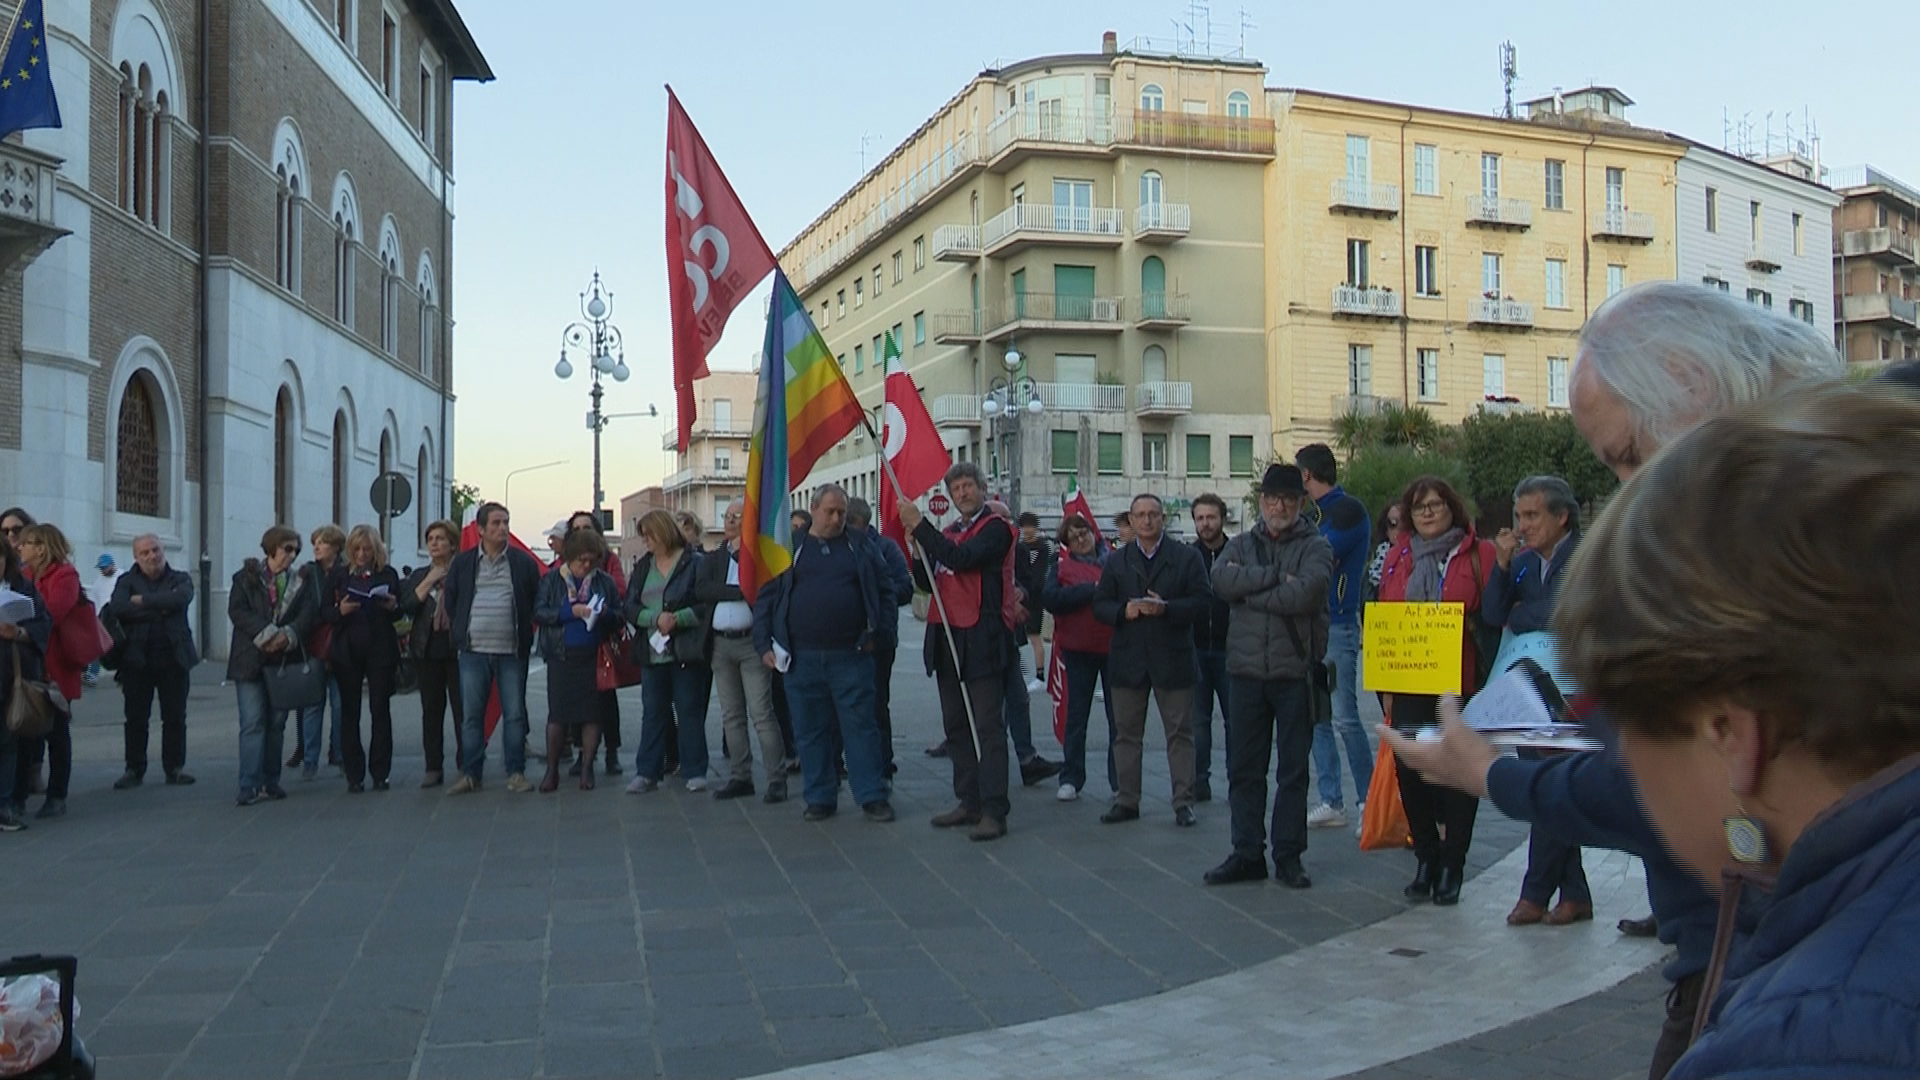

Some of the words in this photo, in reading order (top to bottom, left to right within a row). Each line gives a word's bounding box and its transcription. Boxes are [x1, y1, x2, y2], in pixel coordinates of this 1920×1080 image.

[929, 501, 949, 510] STOP
[1410, 621, 1420, 630] LA
[1378, 636, 1397, 646] SONO
